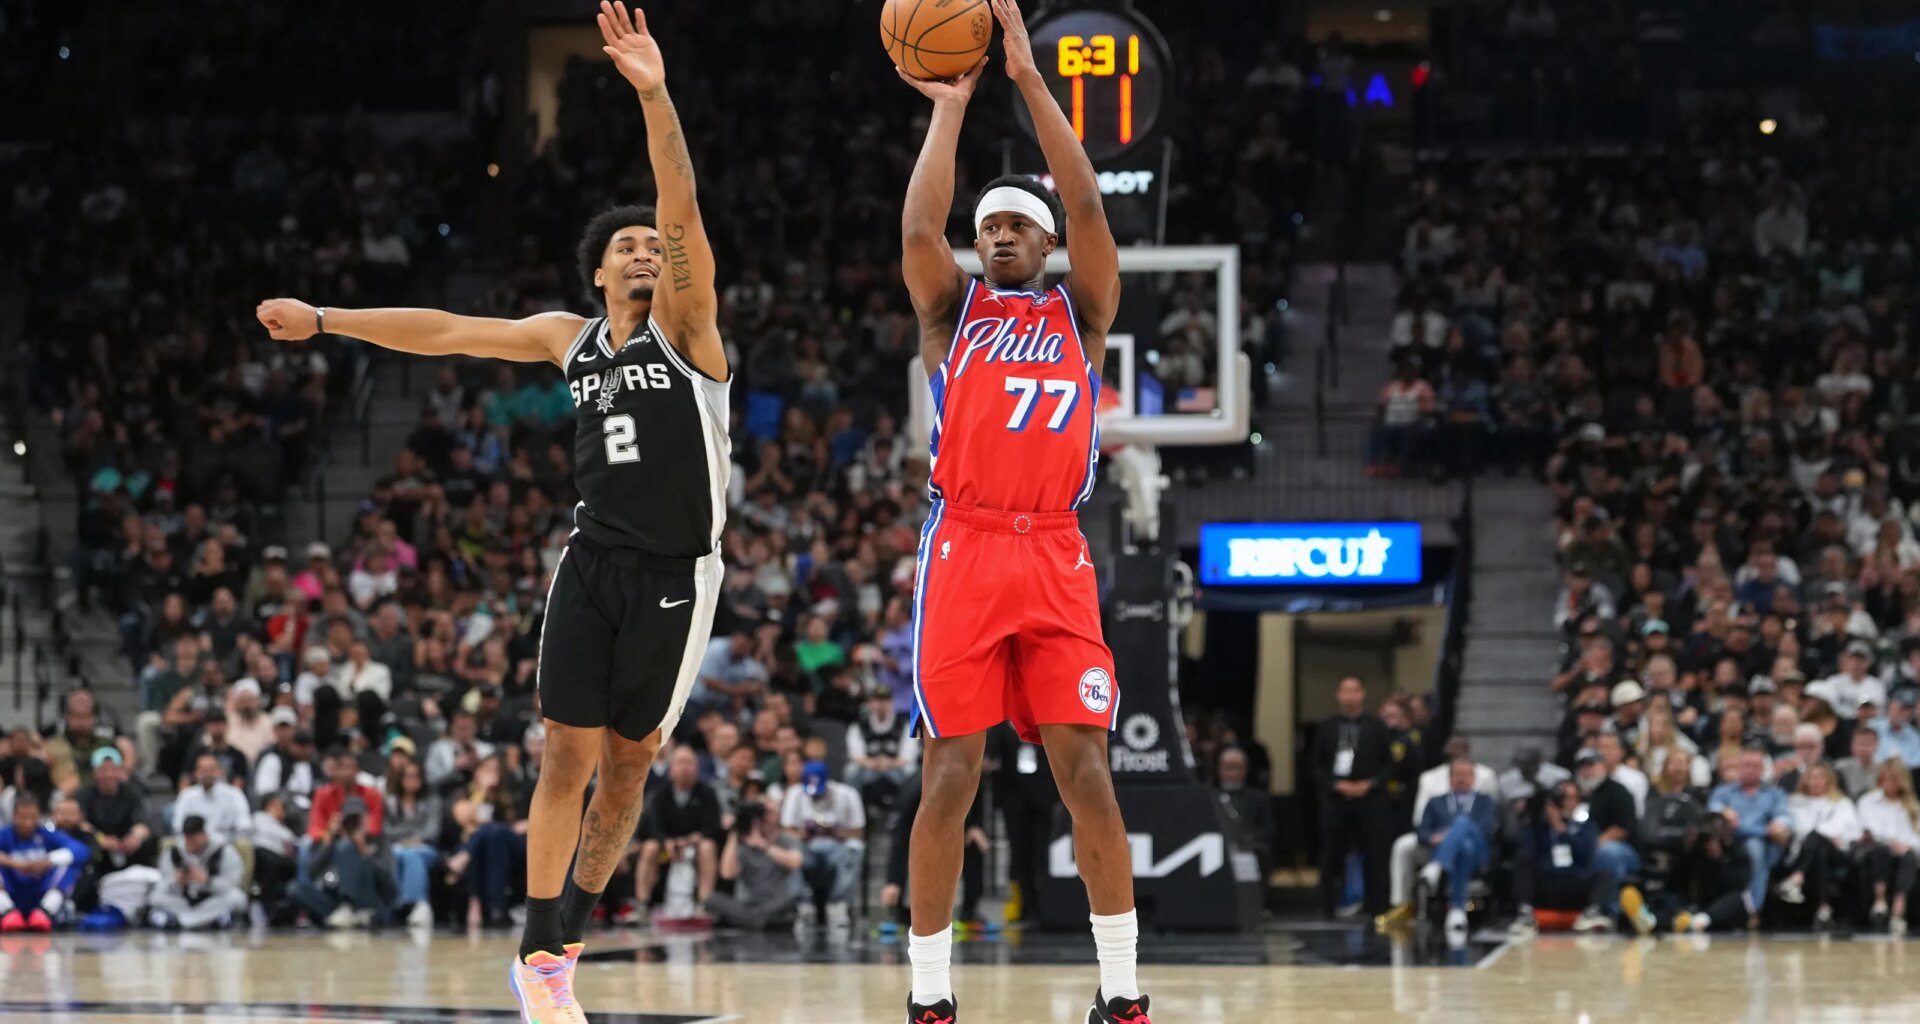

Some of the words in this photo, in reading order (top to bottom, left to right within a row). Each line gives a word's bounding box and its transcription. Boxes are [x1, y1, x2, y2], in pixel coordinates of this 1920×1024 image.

[1057, 34, 1140, 77] 6:31
[1071, 73, 1132, 145] 11
[664, 222, 693, 293] WAWG
[953, 316, 1066, 379] Phila
[569, 363, 672, 413] SPURS
[1004, 376, 1081, 433] 77
[602, 413, 641, 465] 2
